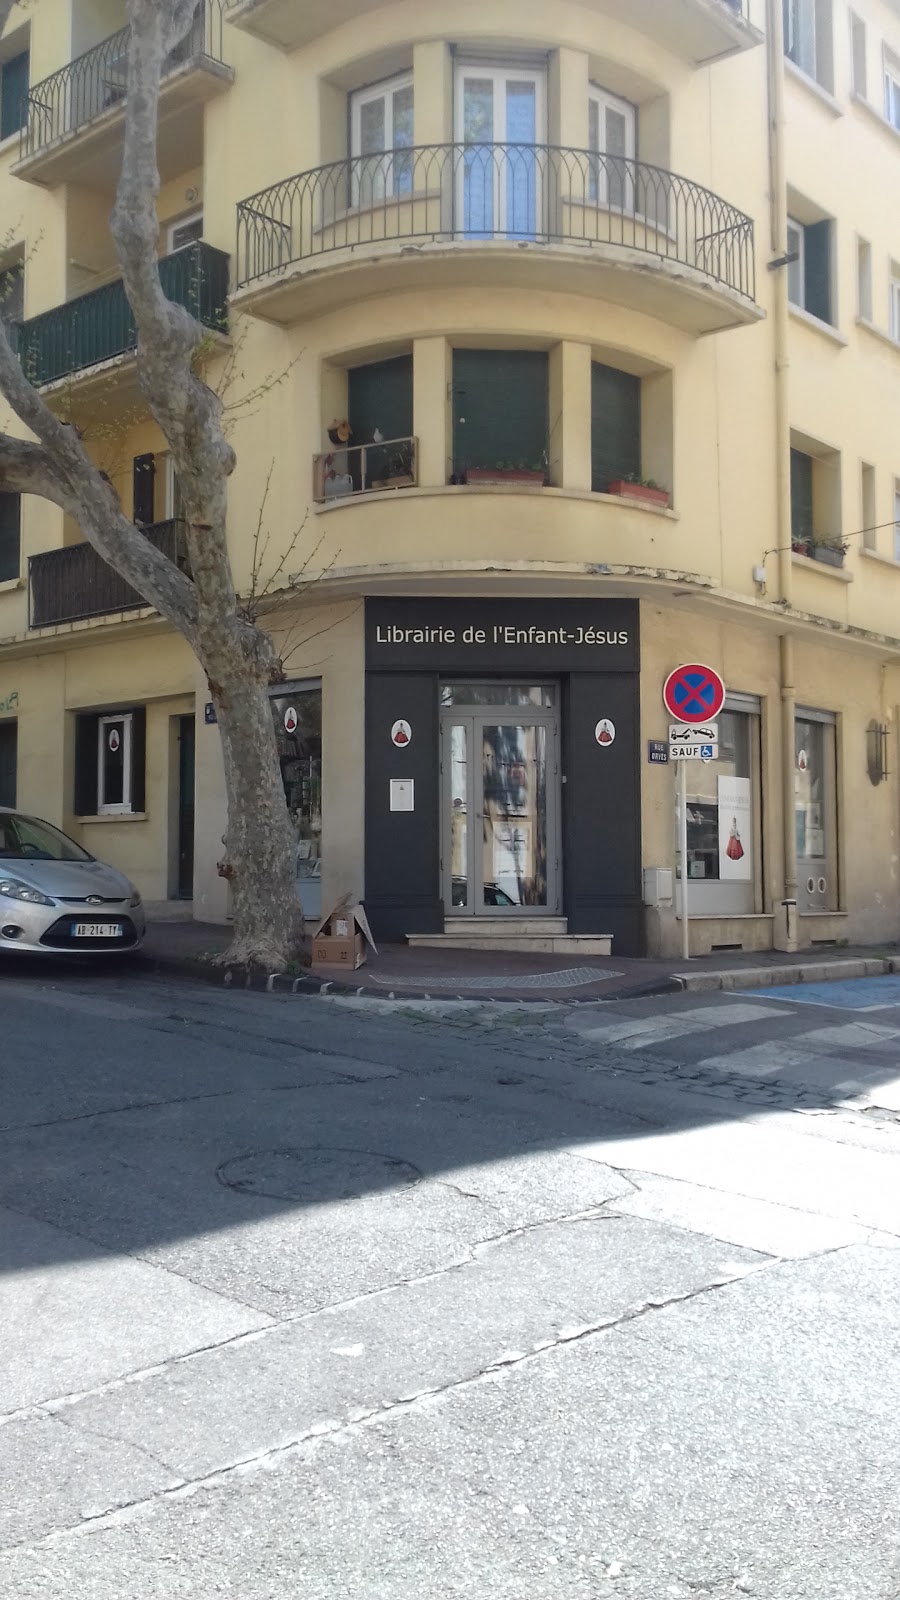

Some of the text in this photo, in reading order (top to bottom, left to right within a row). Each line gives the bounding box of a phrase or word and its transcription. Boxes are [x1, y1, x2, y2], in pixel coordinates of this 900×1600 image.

[376, 625, 628, 644] Librairie de l'Enfant-Jésus
[671, 747, 699, 756] SAUF
